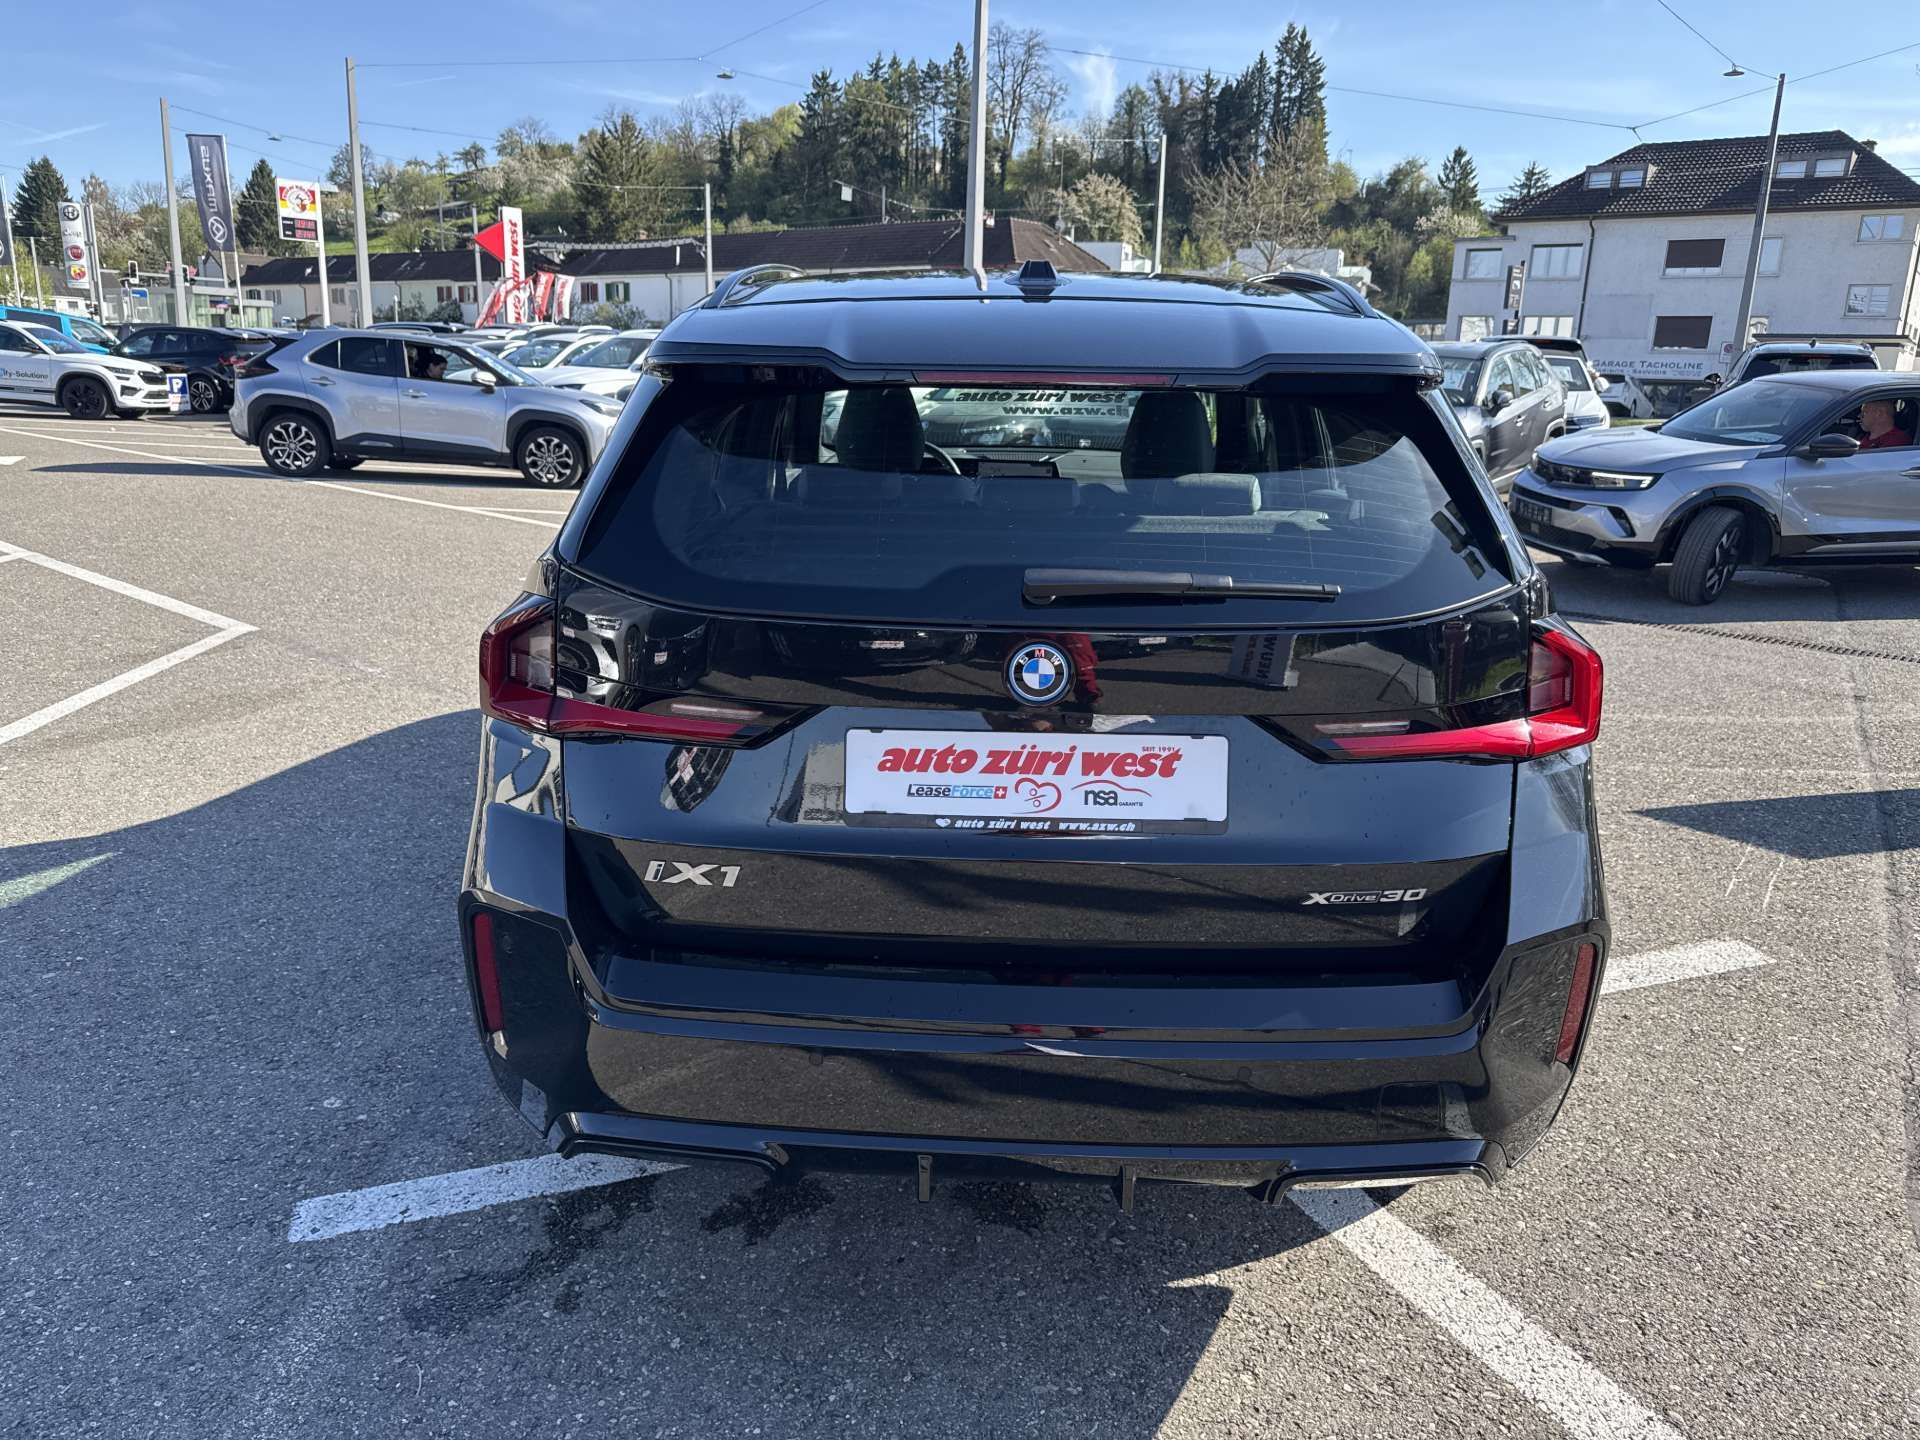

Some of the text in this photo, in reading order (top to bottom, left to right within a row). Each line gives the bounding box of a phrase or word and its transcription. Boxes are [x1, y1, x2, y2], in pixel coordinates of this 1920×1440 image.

[173, 378, 183, 393] P
[956, 390, 1128, 403] auto züri west
[1018, 649, 1062, 667] BMW
[877, 743, 1183, 778] auto züri west
[907, 784, 994, 799] LeaseForce
[1084, 789, 1119, 806] nsa
[954, 818, 985, 829] auto
[987, 818, 1017, 830] züri
[1020, 820, 1051, 831] west
[644, 860, 741, 888] iX1
